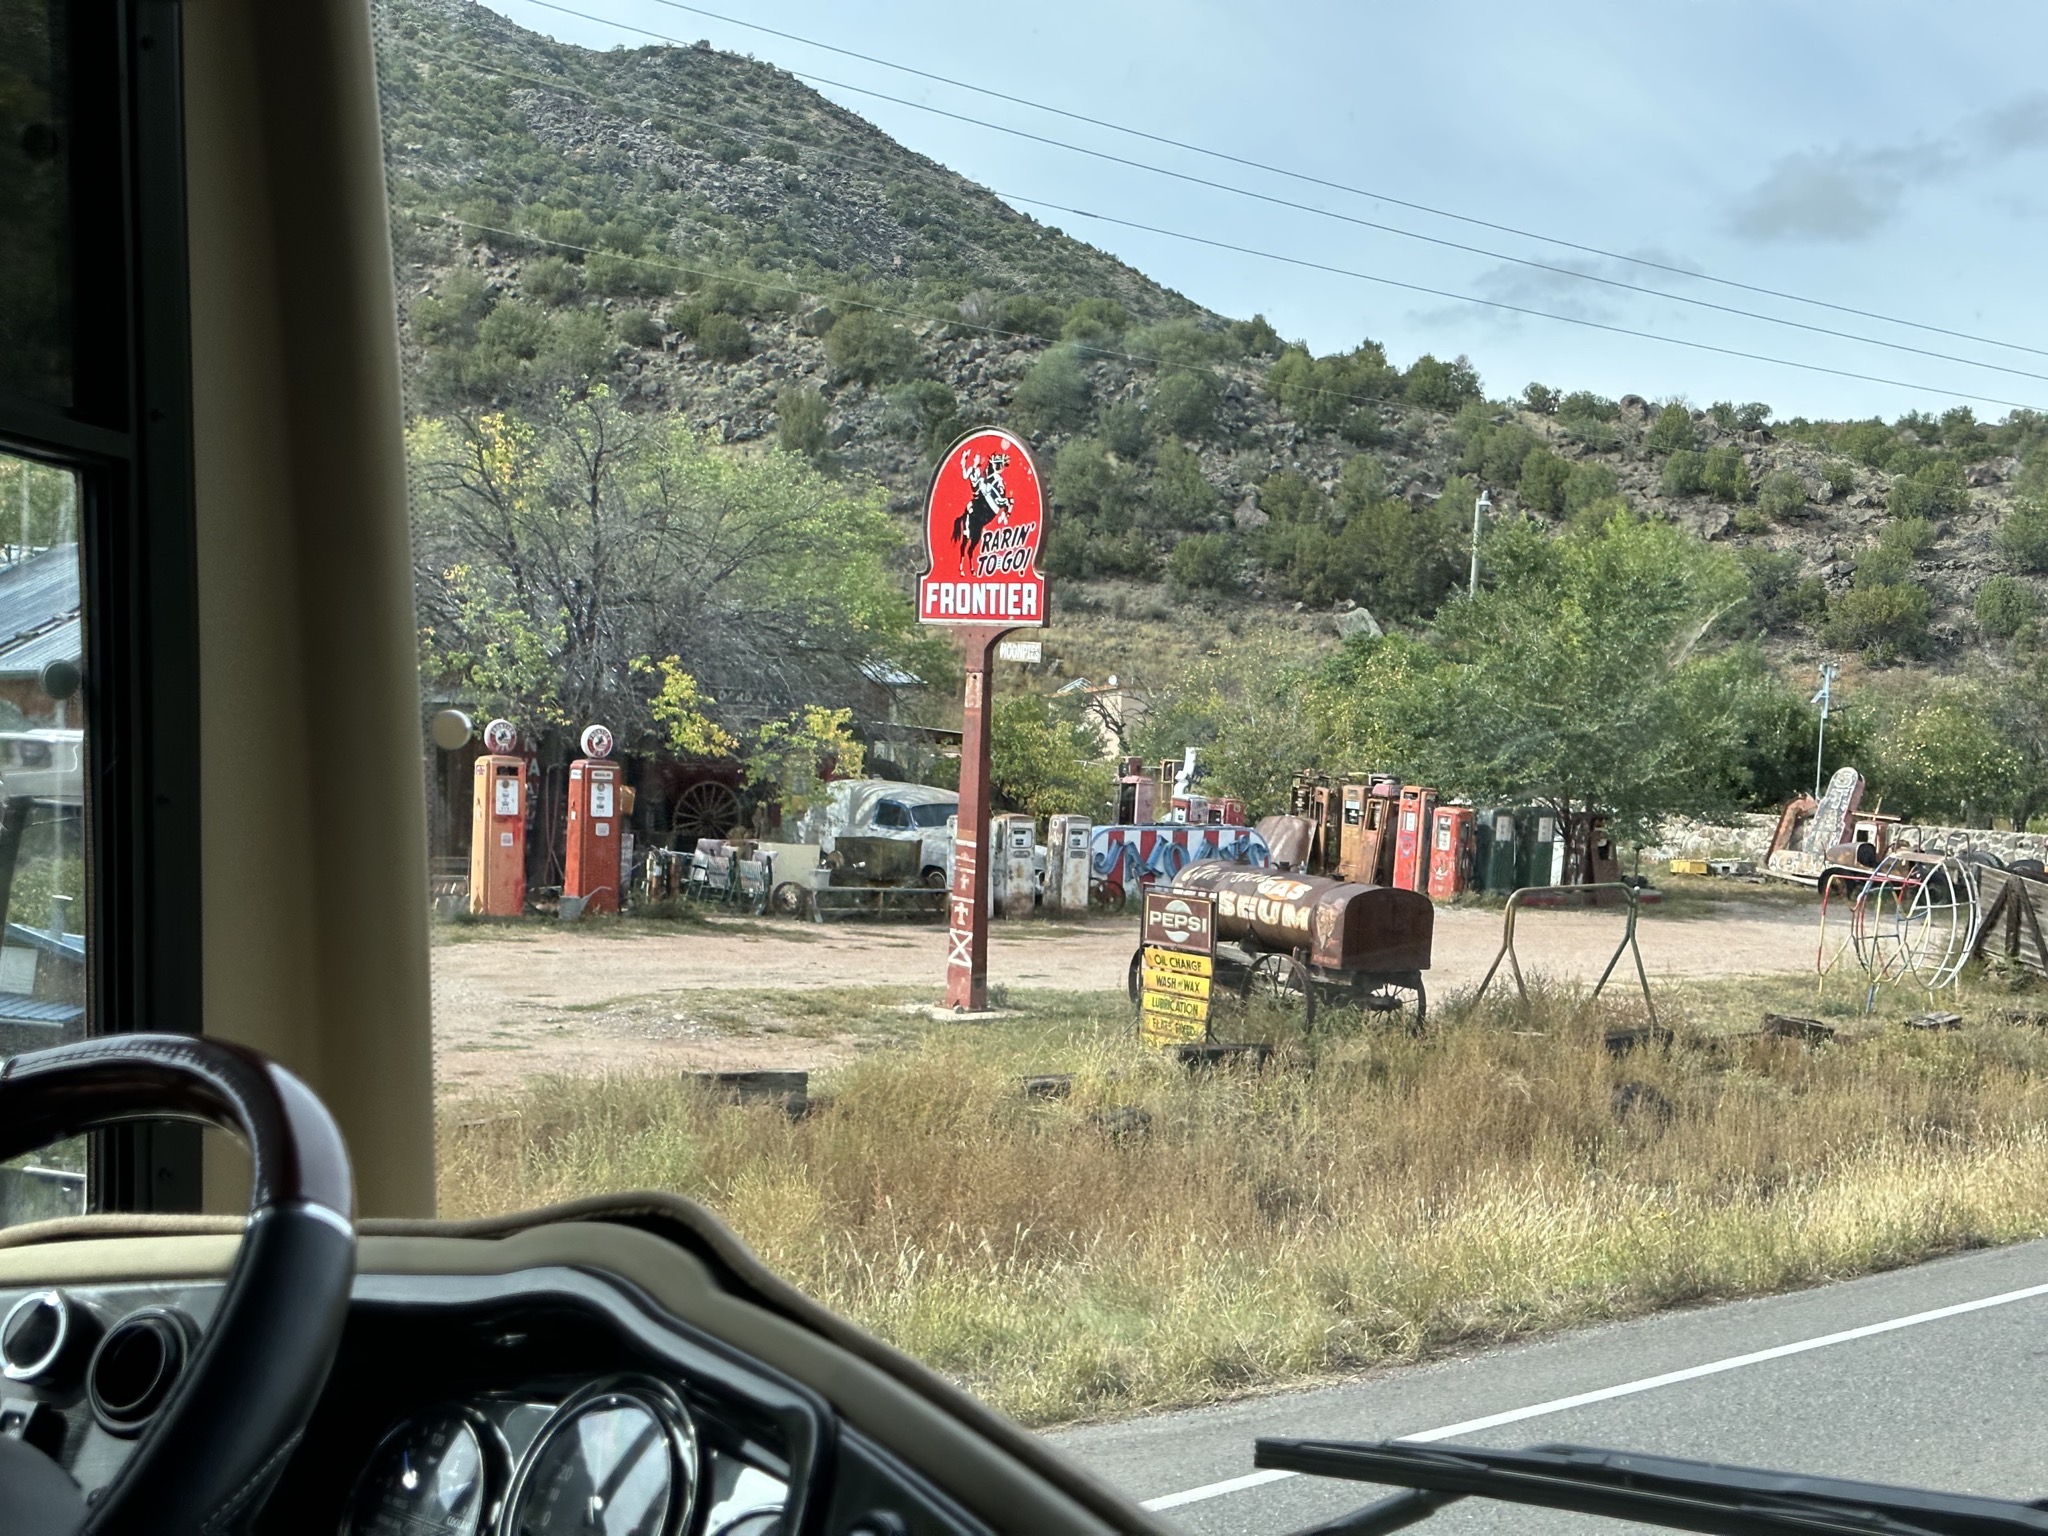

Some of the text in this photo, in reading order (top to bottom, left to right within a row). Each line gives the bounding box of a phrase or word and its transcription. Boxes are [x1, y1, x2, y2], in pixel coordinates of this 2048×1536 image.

[981, 522, 1035, 553] RARIN'
[978, 549, 1032, 577] TO GO!
[925, 582, 1038, 616] FRONTIER
[1257, 878, 1313, 901] GAS
[1149, 910, 1207, 934] PEPSI
[1154, 954, 1202, 971] OIL CHANGE
[1155, 975, 1177, 989] WASH
[1183, 979, 1200, 993] WAX
[1152, 996, 1199, 1016] LUBRICATION
